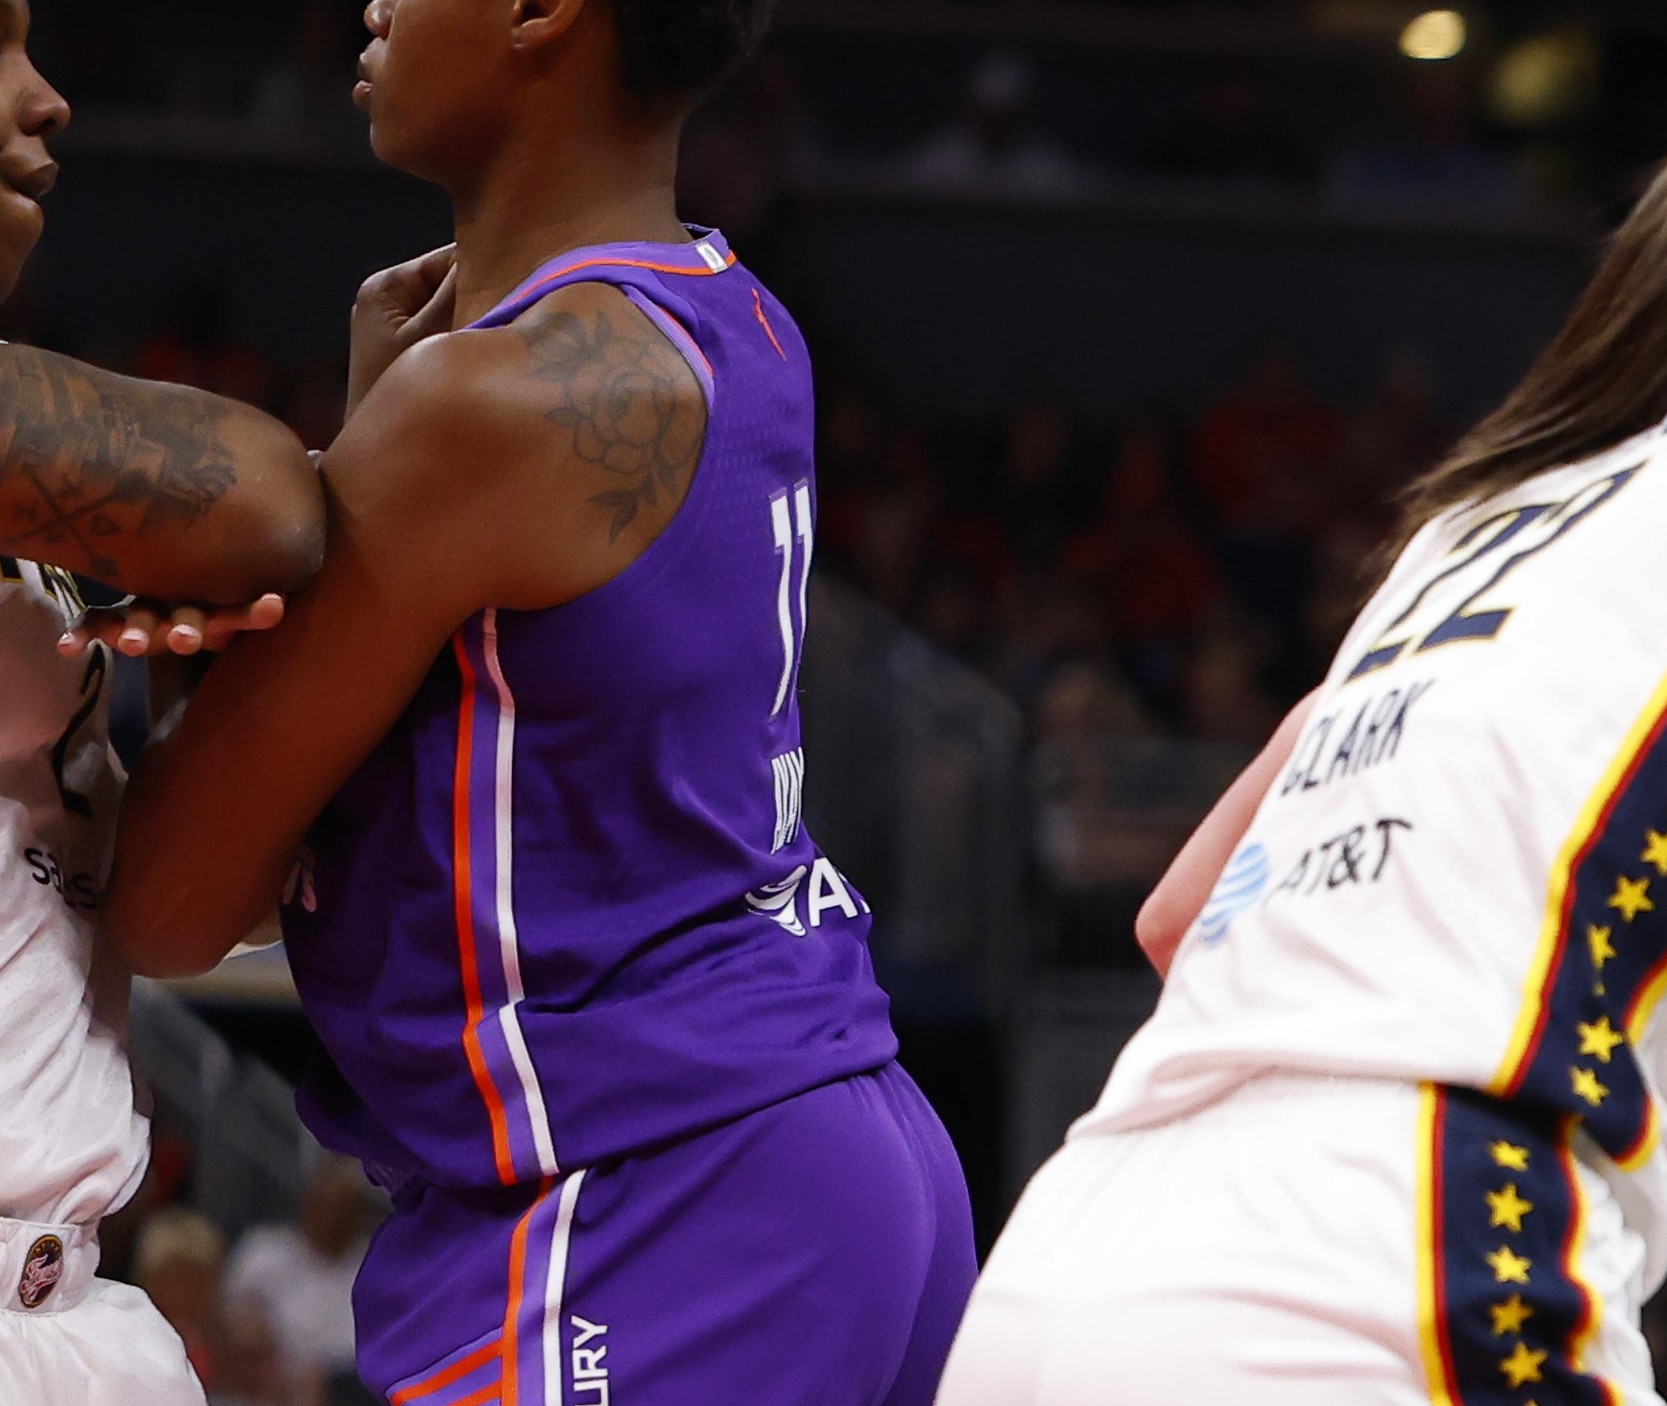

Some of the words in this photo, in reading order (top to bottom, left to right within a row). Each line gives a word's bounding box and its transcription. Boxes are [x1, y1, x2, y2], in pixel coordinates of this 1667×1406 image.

[769, 480, 814, 723] 11
[1344, 458, 1650, 685] 22
[1281, 678, 1437, 796] CLARK
[1263, 816, 1414, 906] AT&T
